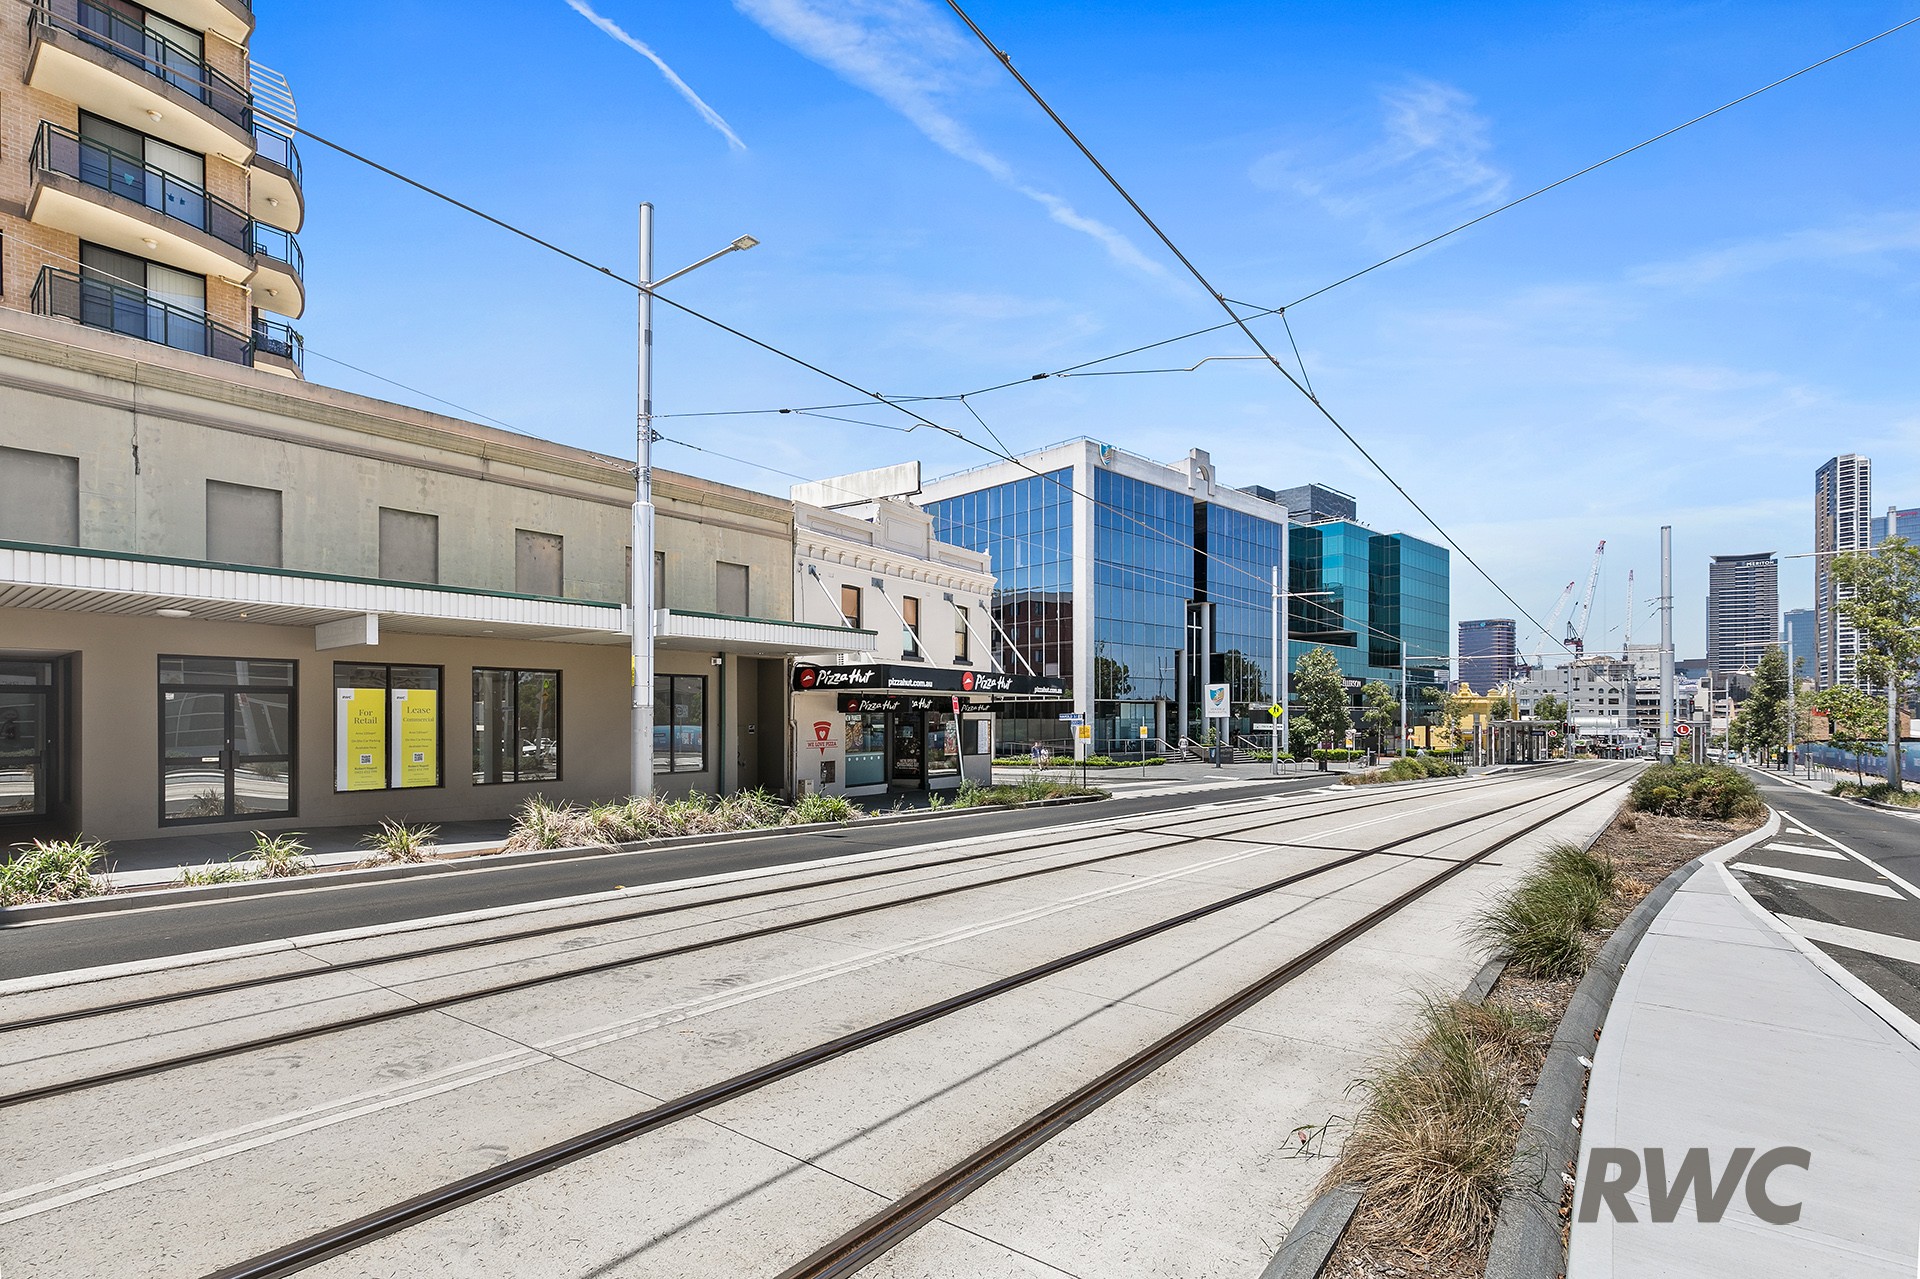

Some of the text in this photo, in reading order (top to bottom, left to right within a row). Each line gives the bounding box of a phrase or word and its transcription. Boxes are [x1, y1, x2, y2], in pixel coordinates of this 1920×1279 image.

[815, 668, 875, 686] Pizza Hut
[888, 677, 933, 687] pizzahut.com.au
[975, 673, 1013, 690] Pizza Hut
[858, 700, 882, 711] Pizza
[882, 700, 900, 710] Hut
[918, 698, 933, 710] Hut
[961, 703, 977, 712] Pizza
[354, 716, 378, 725] Retail
